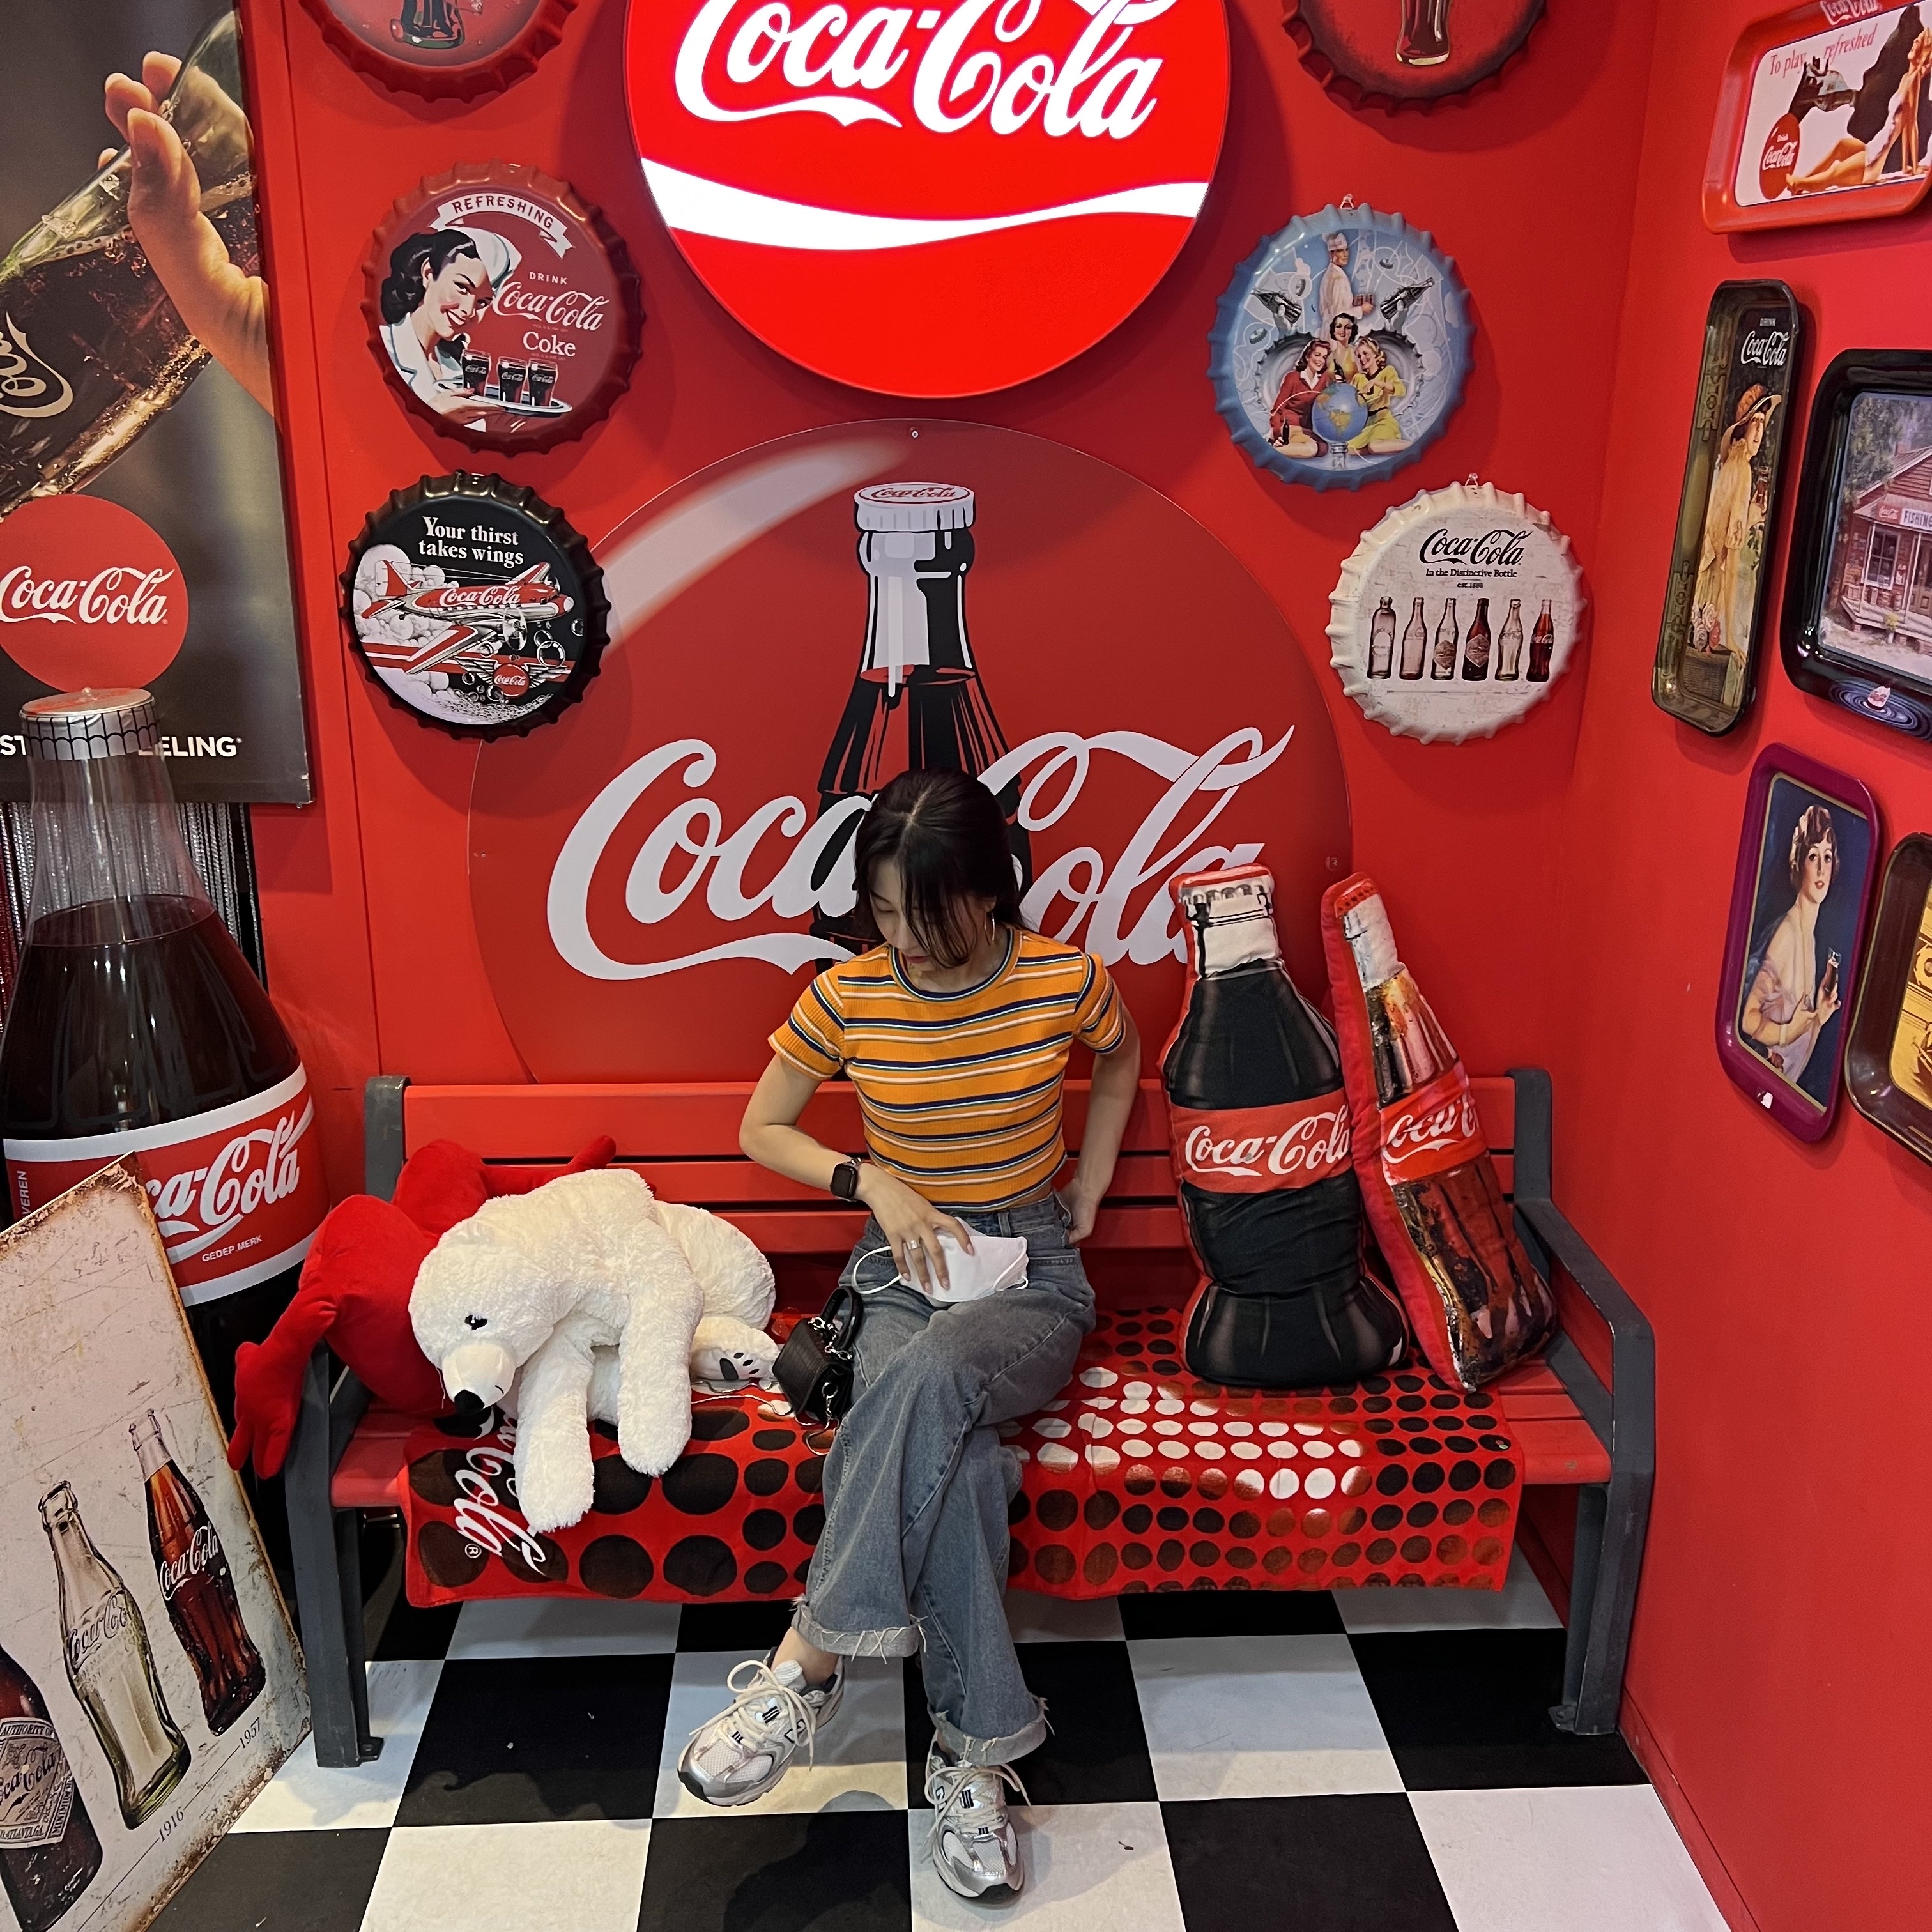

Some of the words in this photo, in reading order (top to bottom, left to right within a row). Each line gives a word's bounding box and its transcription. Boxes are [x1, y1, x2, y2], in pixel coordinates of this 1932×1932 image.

[1769, 55, 1781, 75] To
[1782, 49, 1806, 79] play
[1823, 24, 1878, 65] refreshed
[674, 0, 1177, 139] Coca-Cola
[451, 195, 554, 230] REFRESHING
[529, 272, 568, 286] DRINK
[492, 281, 611, 332] Coca-Cola
[523, 331, 576, 356] Coke
[1740, 330, 1790, 366] Coca-Cola
[871, 487, 956, 498] Coca-Cola
[422, 516, 466, 539] Your
[470, 525, 519, 546] thirst
[1419, 528, 1534, 565] Coca-Cola
[418, 540, 467, 559] takes
[471, 546, 524, 569] wings
[1425, 568, 1434, 576] In
[1436, 568, 1448, 576] the
[1450, 568, 1492, 578] Distinctive
[1494, 569, 1517, 578] Bottle
[0, 565, 175, 624] Coca-Cola
[439, 585, 523, 607] Coca-Cola
[237, 1235, 263, 1251] MERK
[160, 1521, 218, 1601] Coca-Cola
[239, 1716, 261, 1749] 1957
[158, 1805, 184, 1843] 1916
